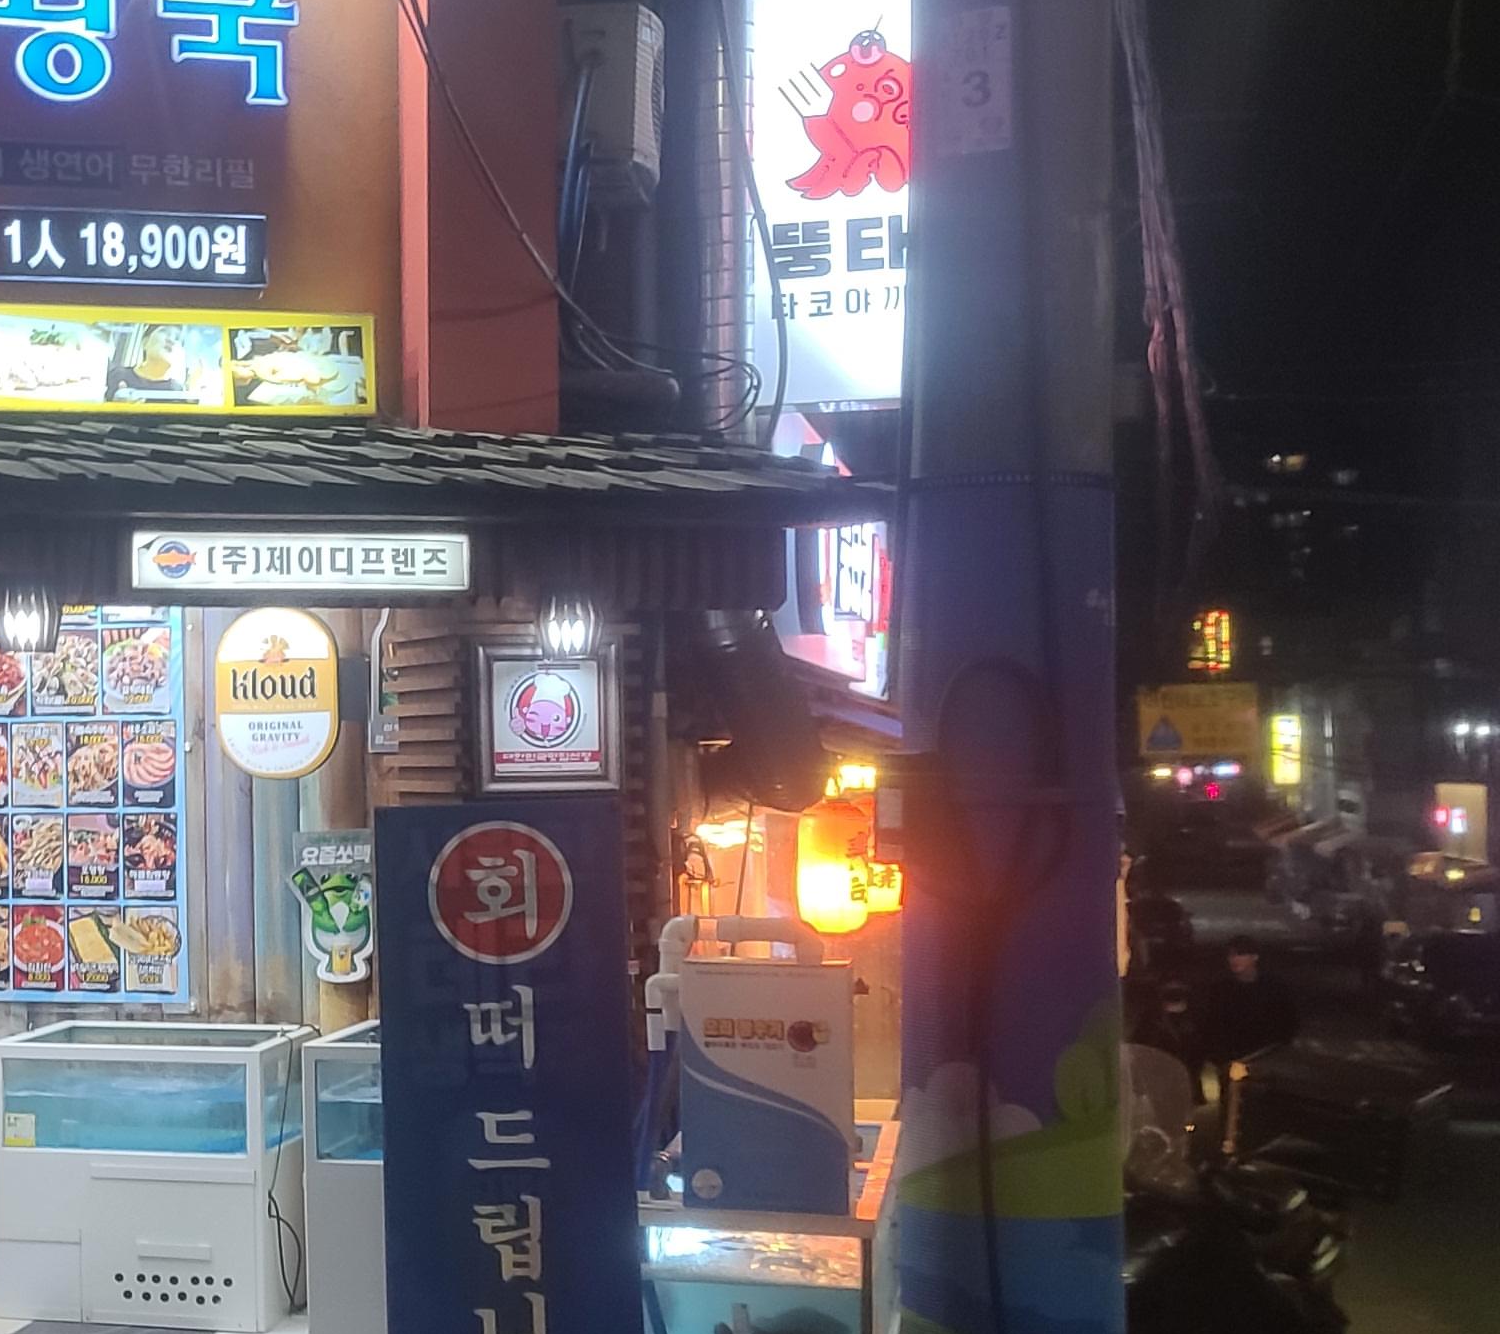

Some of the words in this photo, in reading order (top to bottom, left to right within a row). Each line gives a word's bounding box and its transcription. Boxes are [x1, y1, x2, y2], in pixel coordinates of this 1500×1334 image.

[18, 145, 117, 185] 생연어
[129, 153, 256, 191] 무한리필
[79, 221, 249, 274] 18,900원
[207, 545, 448, 576] (주)제이디프렌즈
[231, 666, 317, 701] Kloud
[248, 720, 303, 731] ORIGINAL
[252, 732, 300, 742] GRAVITY
[462, 849, 540, 941] 회
